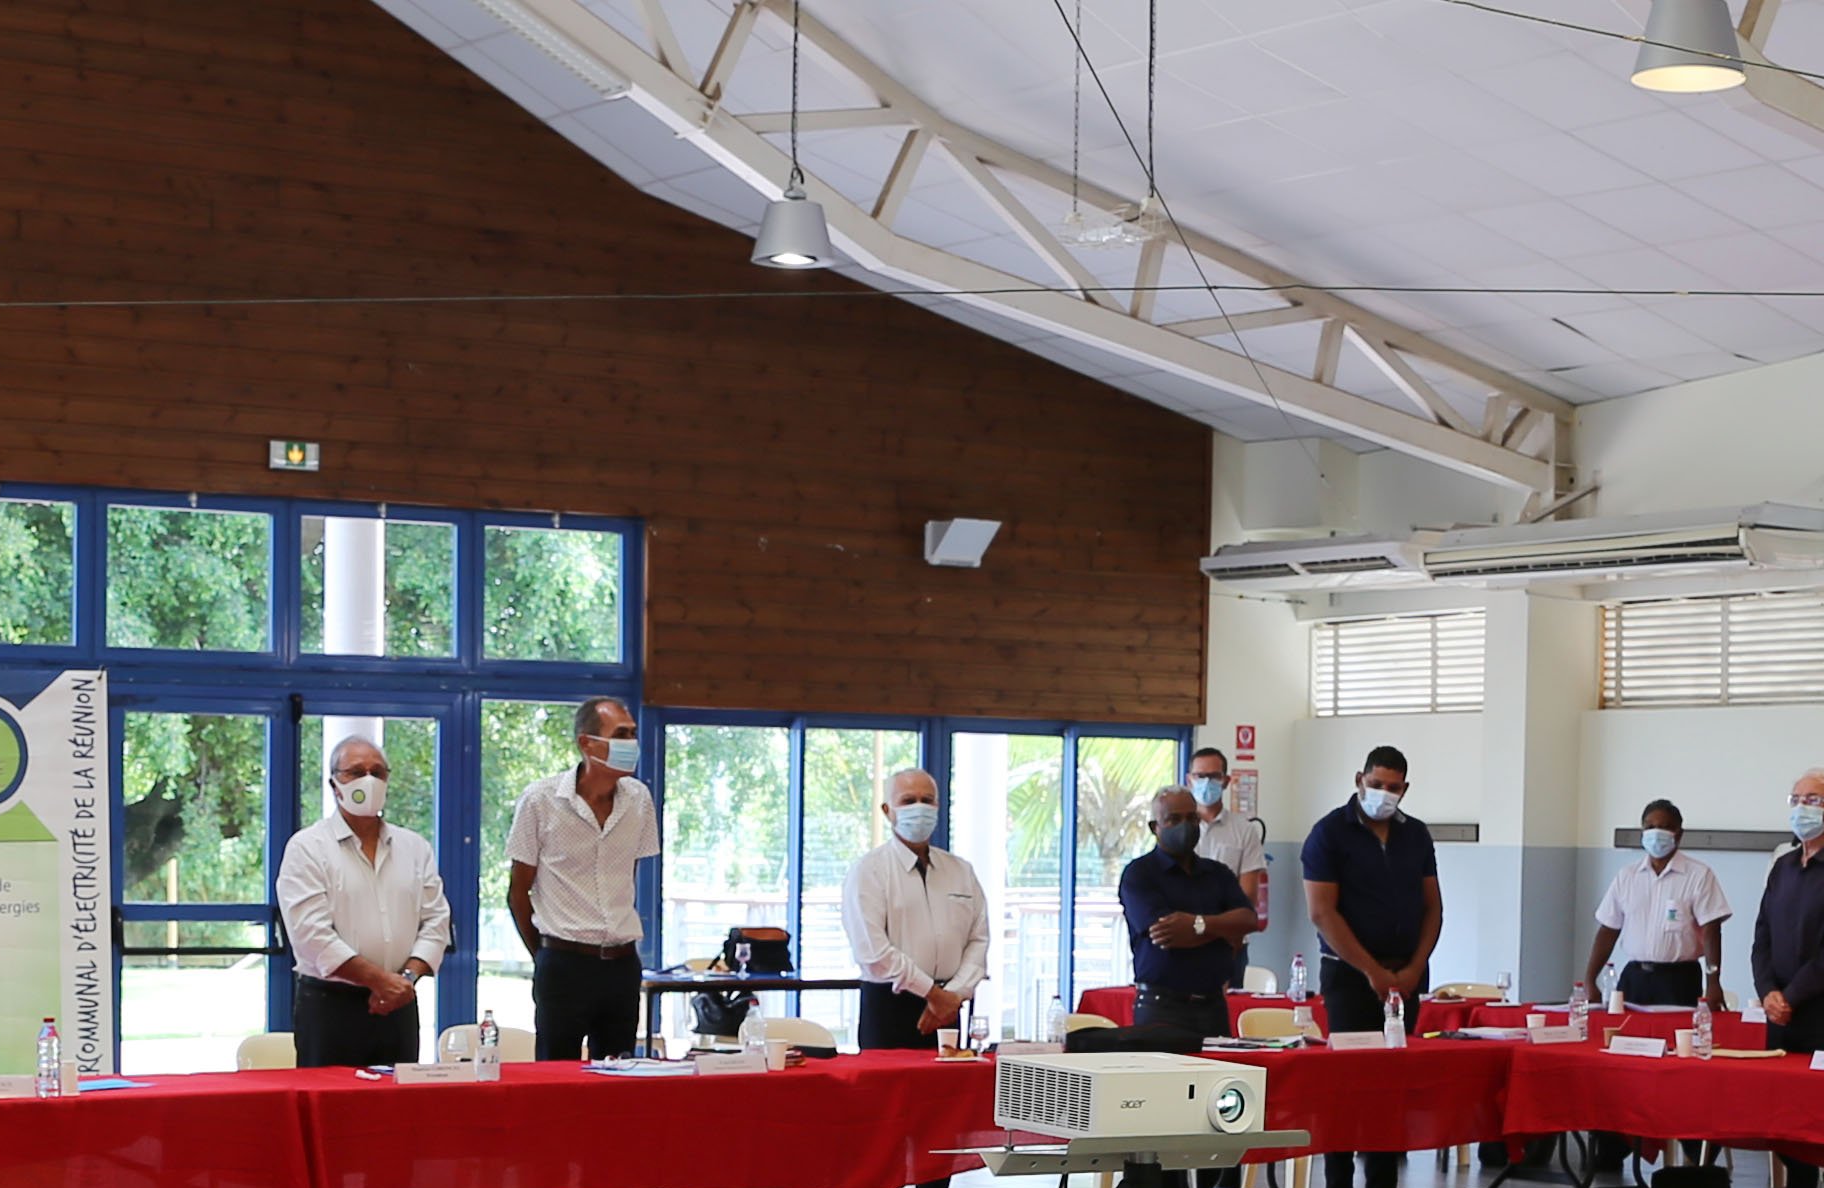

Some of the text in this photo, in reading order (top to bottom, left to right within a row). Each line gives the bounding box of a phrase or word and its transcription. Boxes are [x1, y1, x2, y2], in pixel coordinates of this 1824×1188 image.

[68, 678, 103, 1076] RCOMMUNAL D'ÉLECTRICITÉ DE LA RÉUNION
[1120, 1099, 1147, 1109] acer
